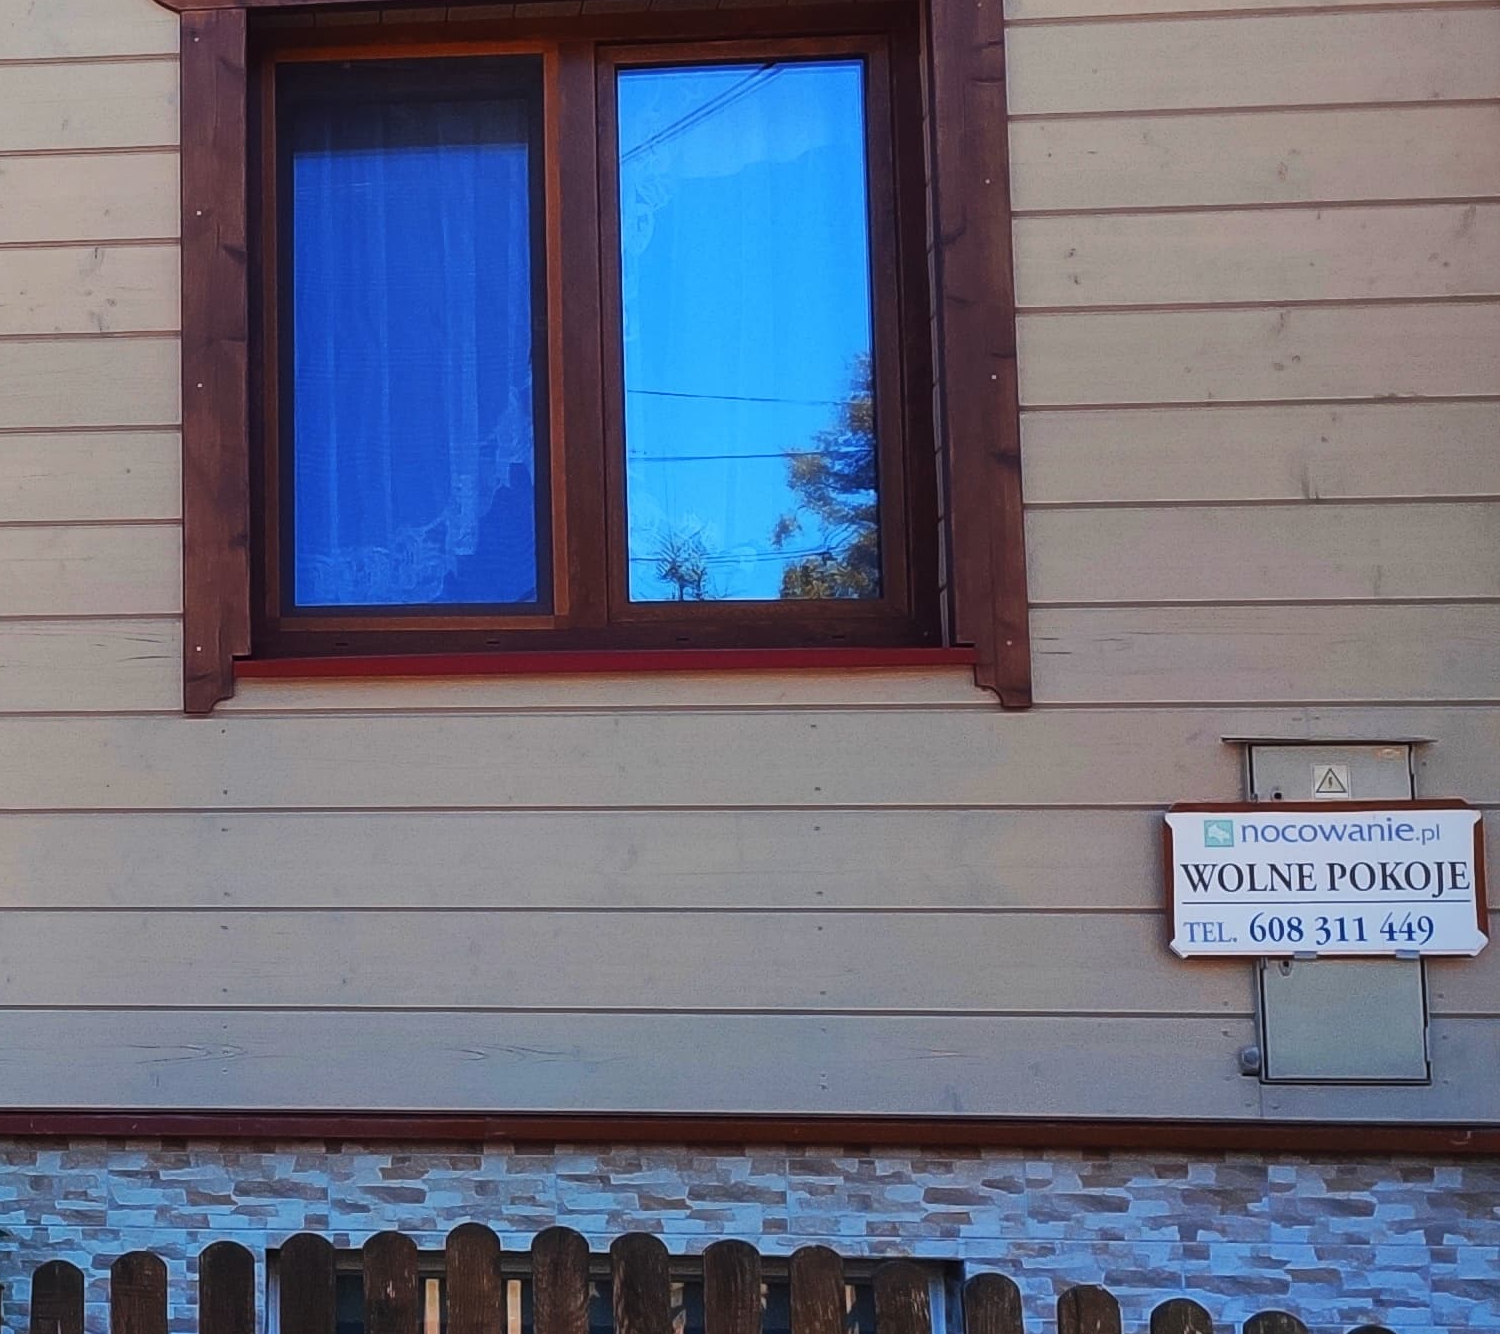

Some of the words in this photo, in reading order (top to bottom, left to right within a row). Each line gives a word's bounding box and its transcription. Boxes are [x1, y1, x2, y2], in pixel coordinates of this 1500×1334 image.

[1240, 817, 1441, 845] nocowanie.pl
[1180, 862, 1318, 893] WOLNE
[1327, 860, 1471, 898] POKOJE
[1183, 921, 1238, 943] TEL.
[1249, 911, 1303, 944] 608
[1316, 916, 1369, 945] 311
[1380, 911, 1434, 945] 449
